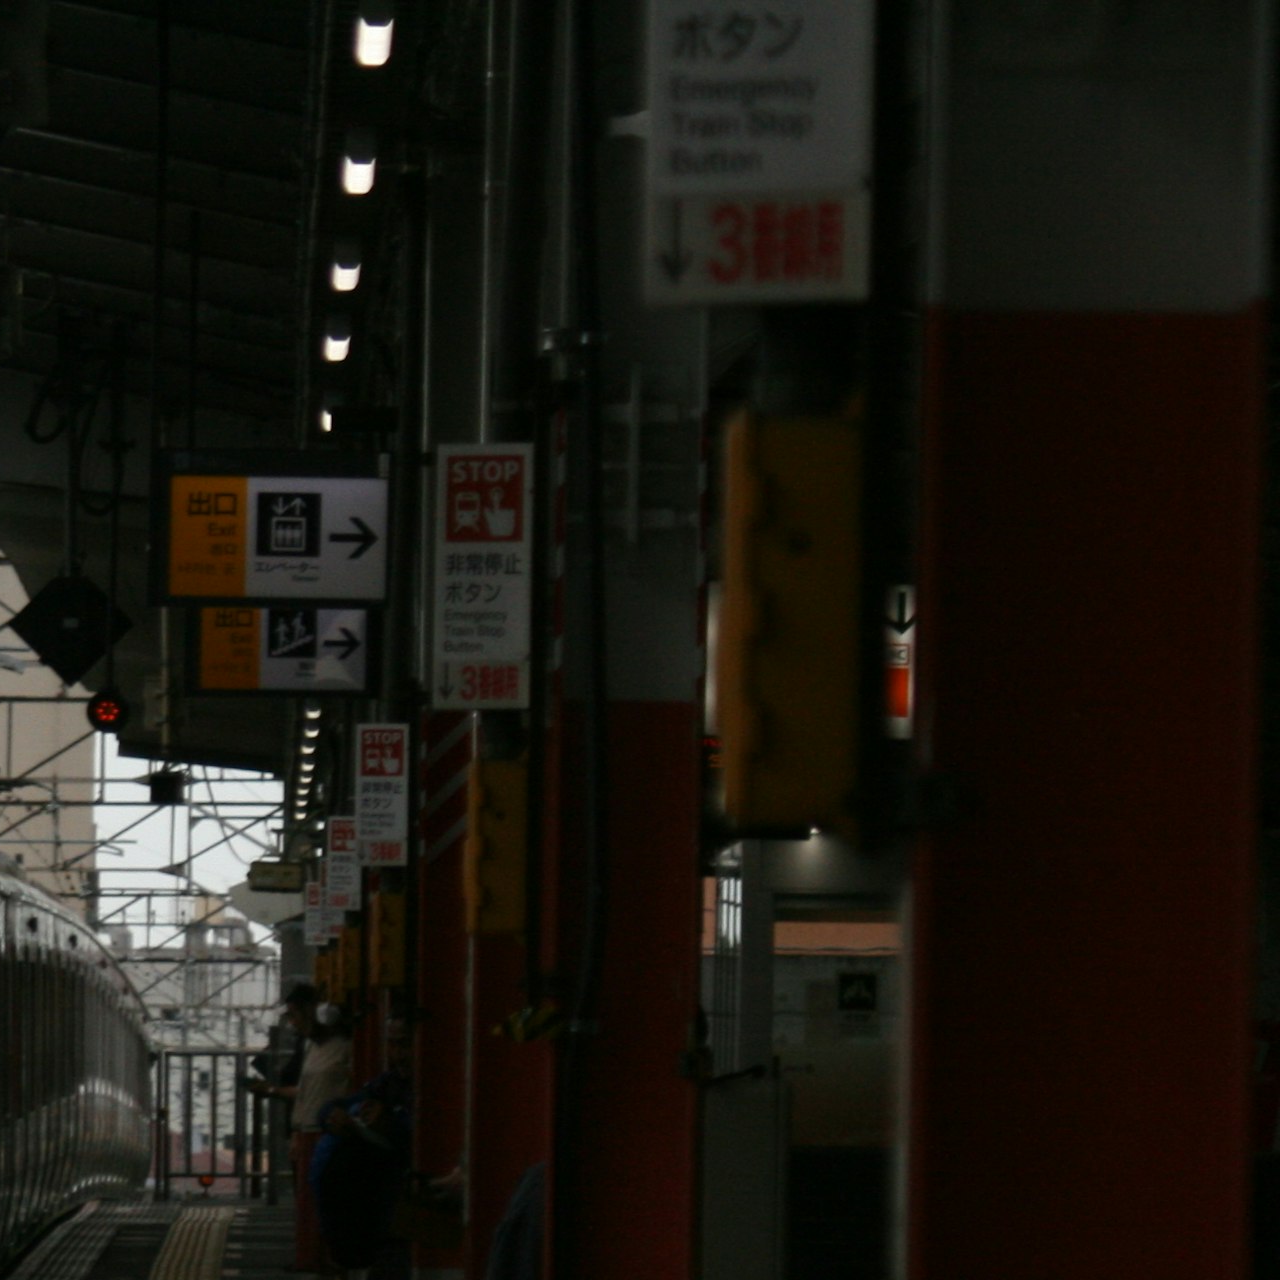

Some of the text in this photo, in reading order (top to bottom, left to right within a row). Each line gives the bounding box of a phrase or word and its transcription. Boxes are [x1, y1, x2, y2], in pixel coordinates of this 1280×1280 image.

[451, 459, 520, 484] STOP
[187, 491, 238, 516] 出口
[446, 581, 502, 604] ボタン
[363, 731, 402, 745] STOP
